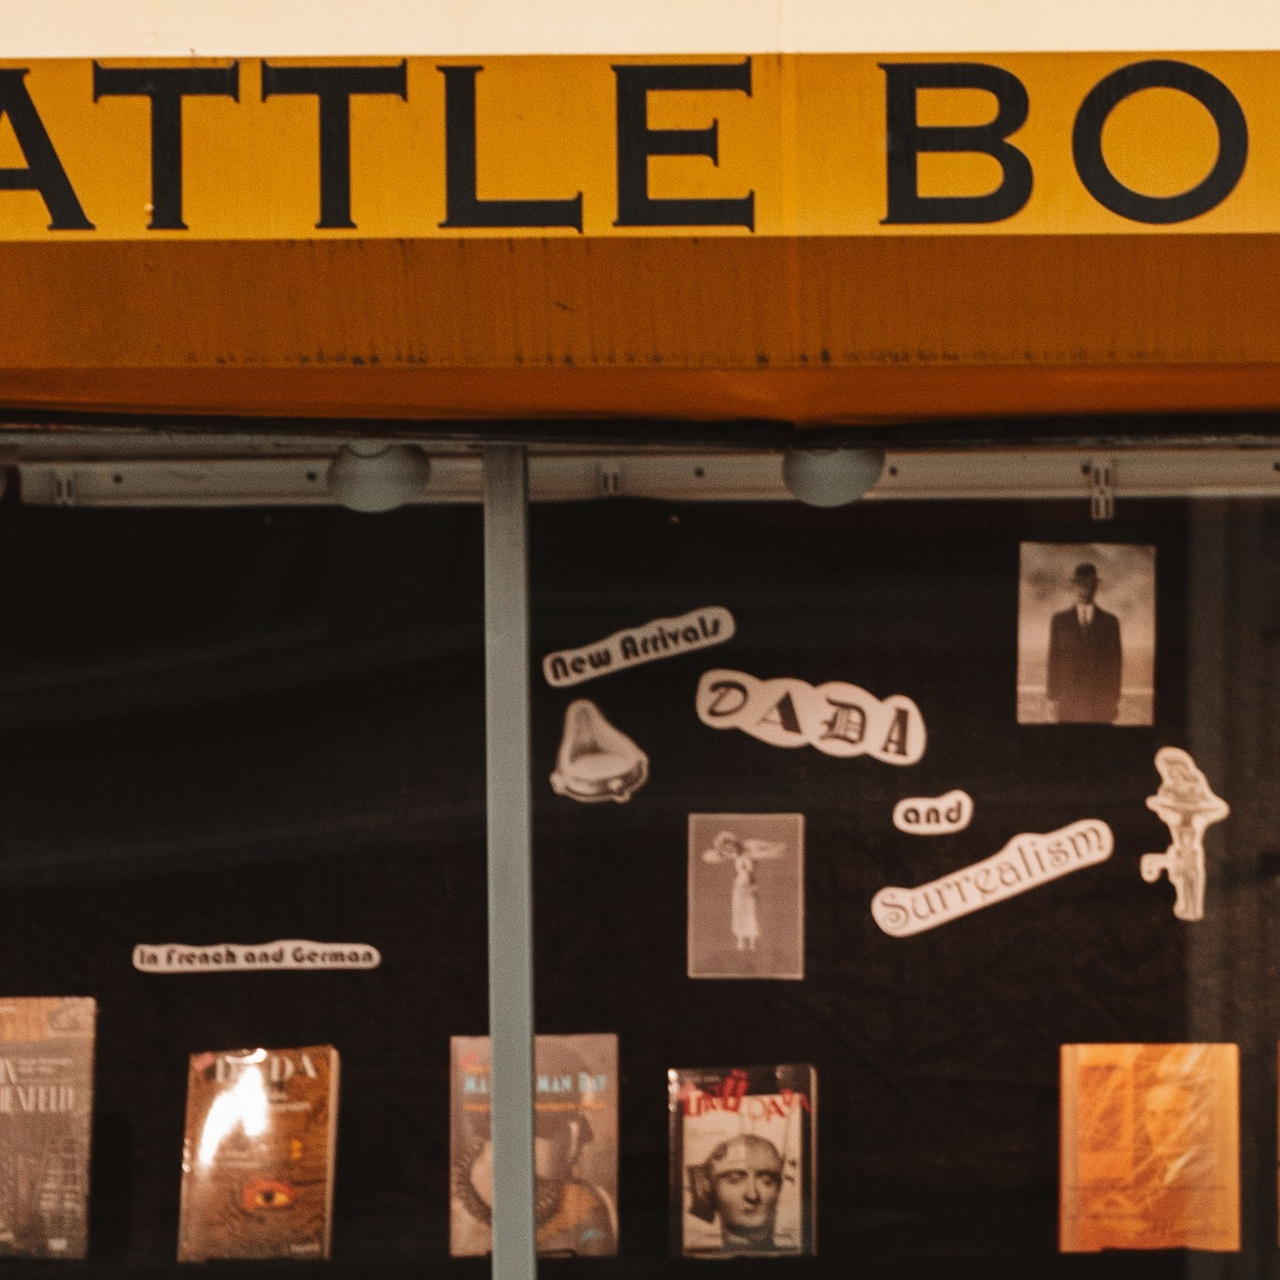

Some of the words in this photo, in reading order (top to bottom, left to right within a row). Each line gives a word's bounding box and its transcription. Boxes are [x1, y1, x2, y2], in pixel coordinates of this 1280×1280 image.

[550, 646, 612, 683] New
[619, 612, 723, 665] Arrivals
[706, 679, 911, 758] DADA
[902, 798, 964, 826] and
[879, 822, 1108, 931] Surrealism
[244, 948, 285, 964] and
[291, 947, 374, 964] German
[214, 1052, 319, 1084] DDA
